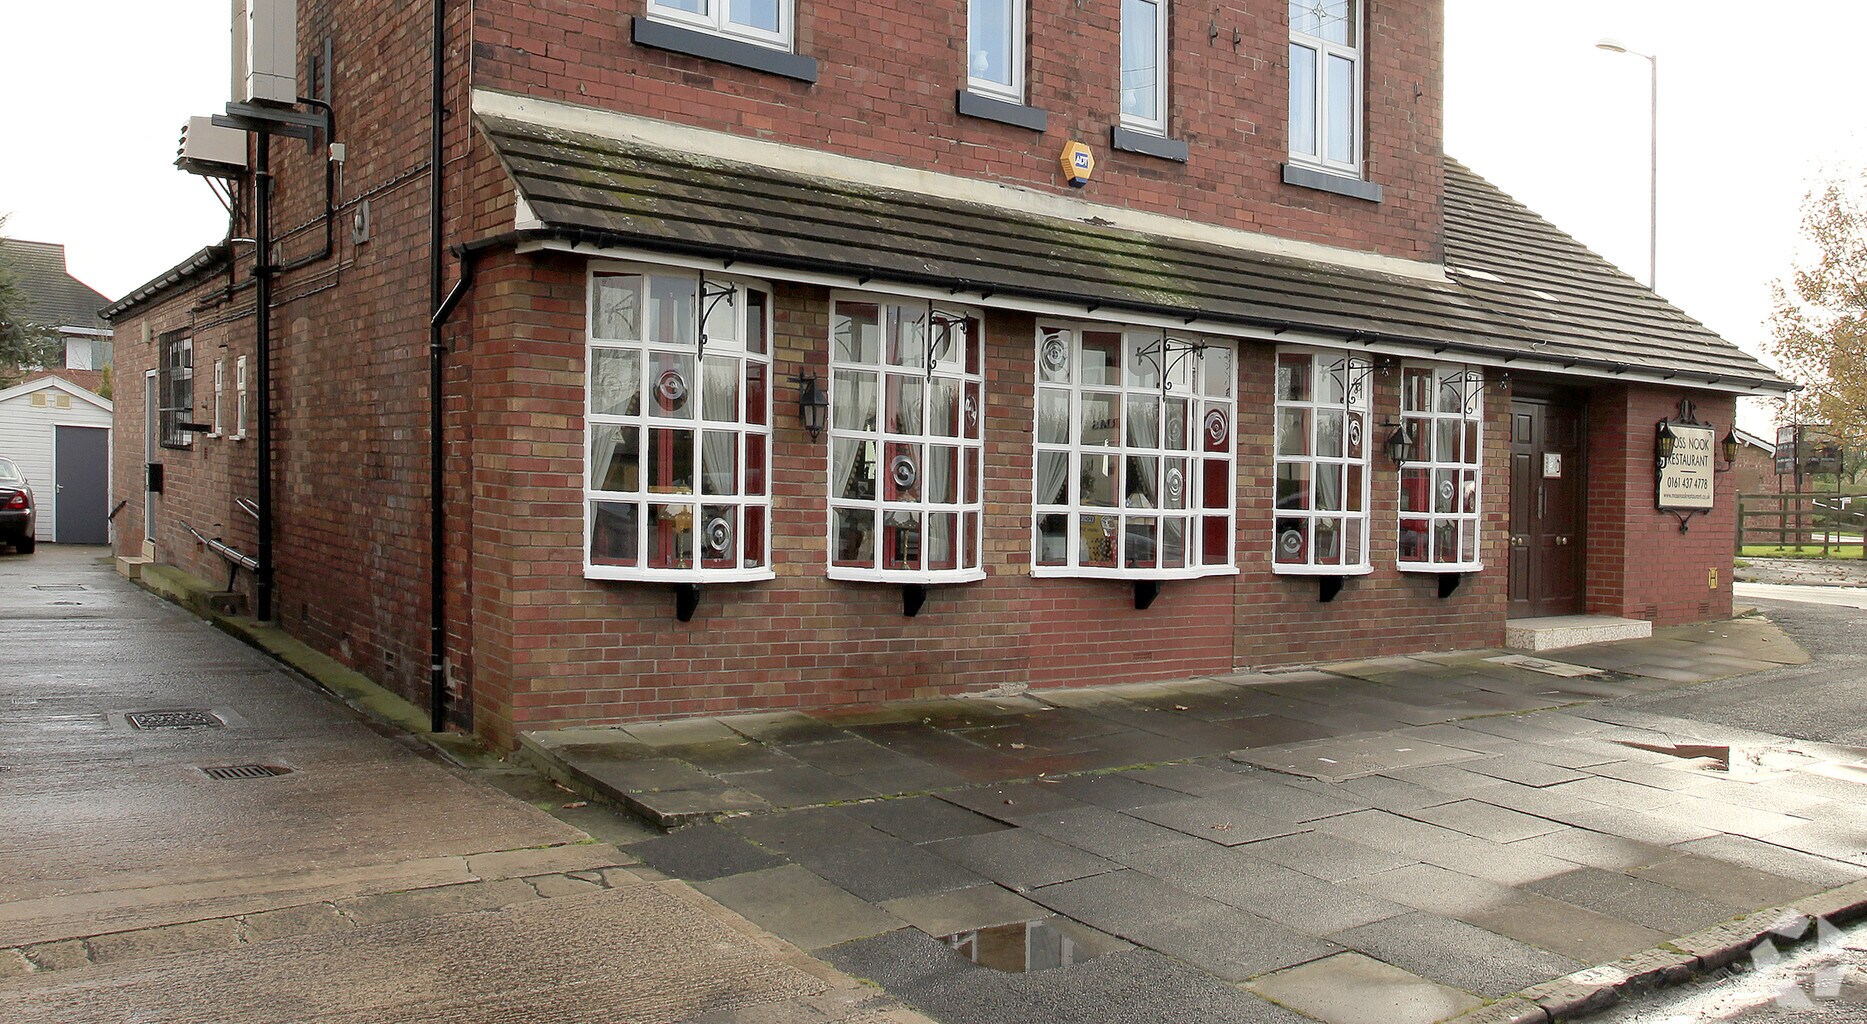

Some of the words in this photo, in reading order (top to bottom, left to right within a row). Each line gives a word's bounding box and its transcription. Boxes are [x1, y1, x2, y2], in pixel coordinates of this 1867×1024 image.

[1673, 437, 1686, 449] OSS
[1689, 437, 1709, 451] NOOK
[1667, 477, 1680, 488] 0161
[1682, 478, 1693, 489] 437
[1694, 478, 1708, 490] 4778
